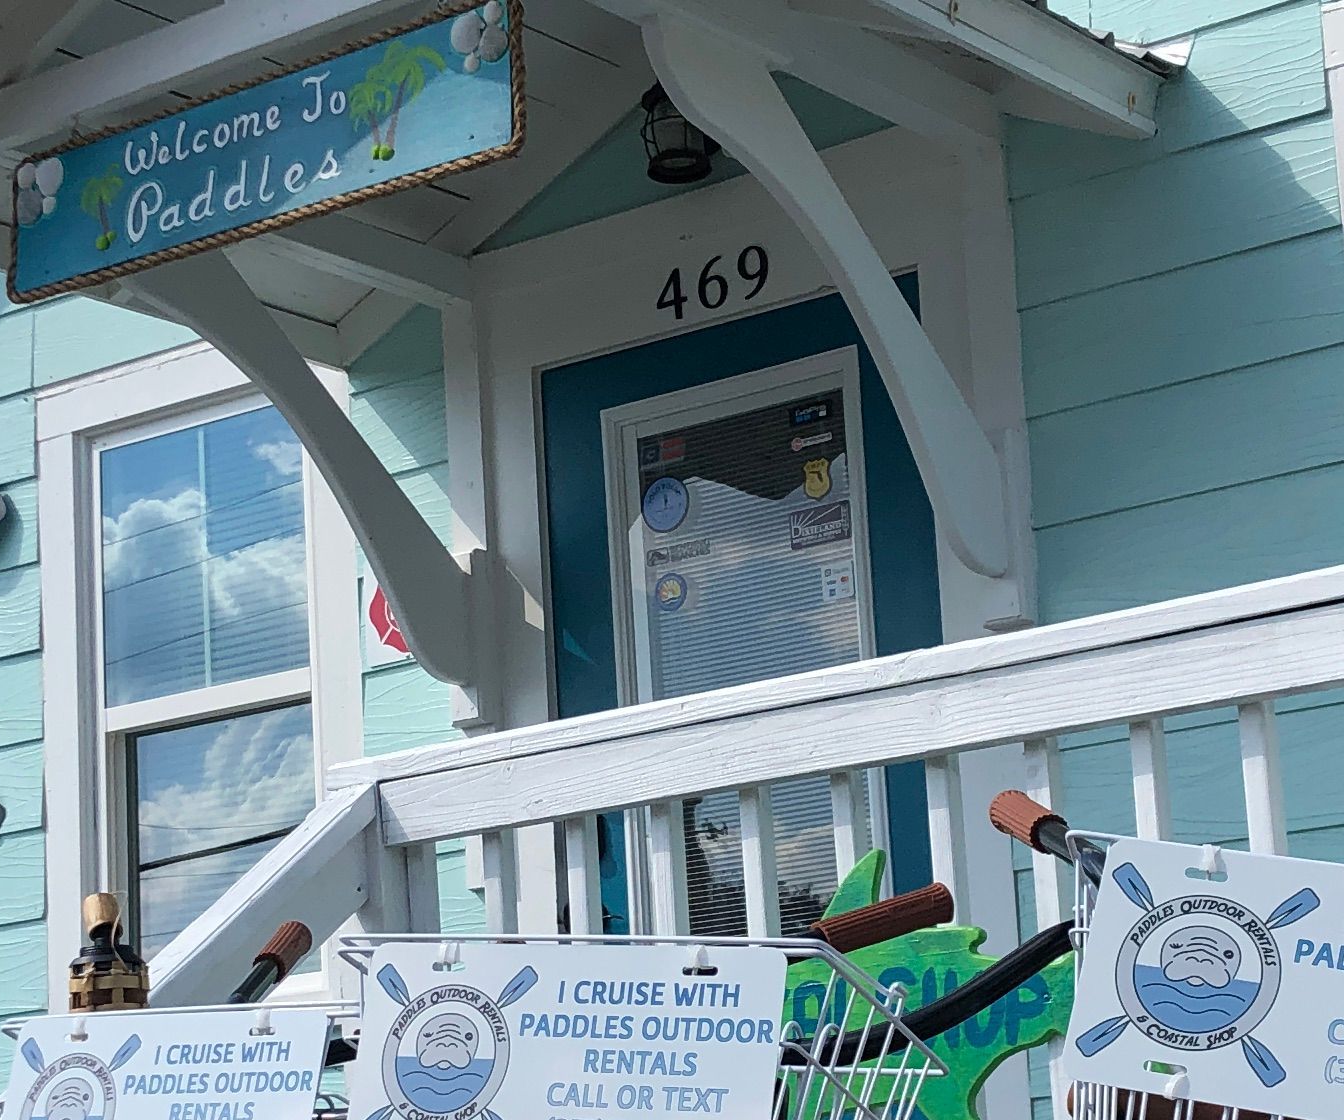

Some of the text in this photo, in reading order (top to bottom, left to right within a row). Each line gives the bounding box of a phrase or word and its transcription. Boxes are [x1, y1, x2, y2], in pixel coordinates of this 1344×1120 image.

[124, 70, 347, 175] Welcome To
[127, 149, 342, 243] Paddles
[656, 245, 769, 320] 469
[1130, 899, 1276, 966] PADDLES OUTDOOR RENTALS
[558, 980, 740, 1007] I CRUISE WITH
[392, 988, 506, 1043] PADDLES OUTDOOR RENTALS
[520, 1014, 773, 1044] PADDLES OUTDOOR
[1146, 1023, 1200, 1047] COASTAL
[1206, 1026, 1237, 1049] SHOP
[153, 1041, 291, 1065] I CRUISE WITH
[584, 1049, 697, 1077] RENTALS
[124, 1070, 313, 1094] PADDLES OUTDOOR
[546, 1082, 728, 1113] CALL OR TEXT
